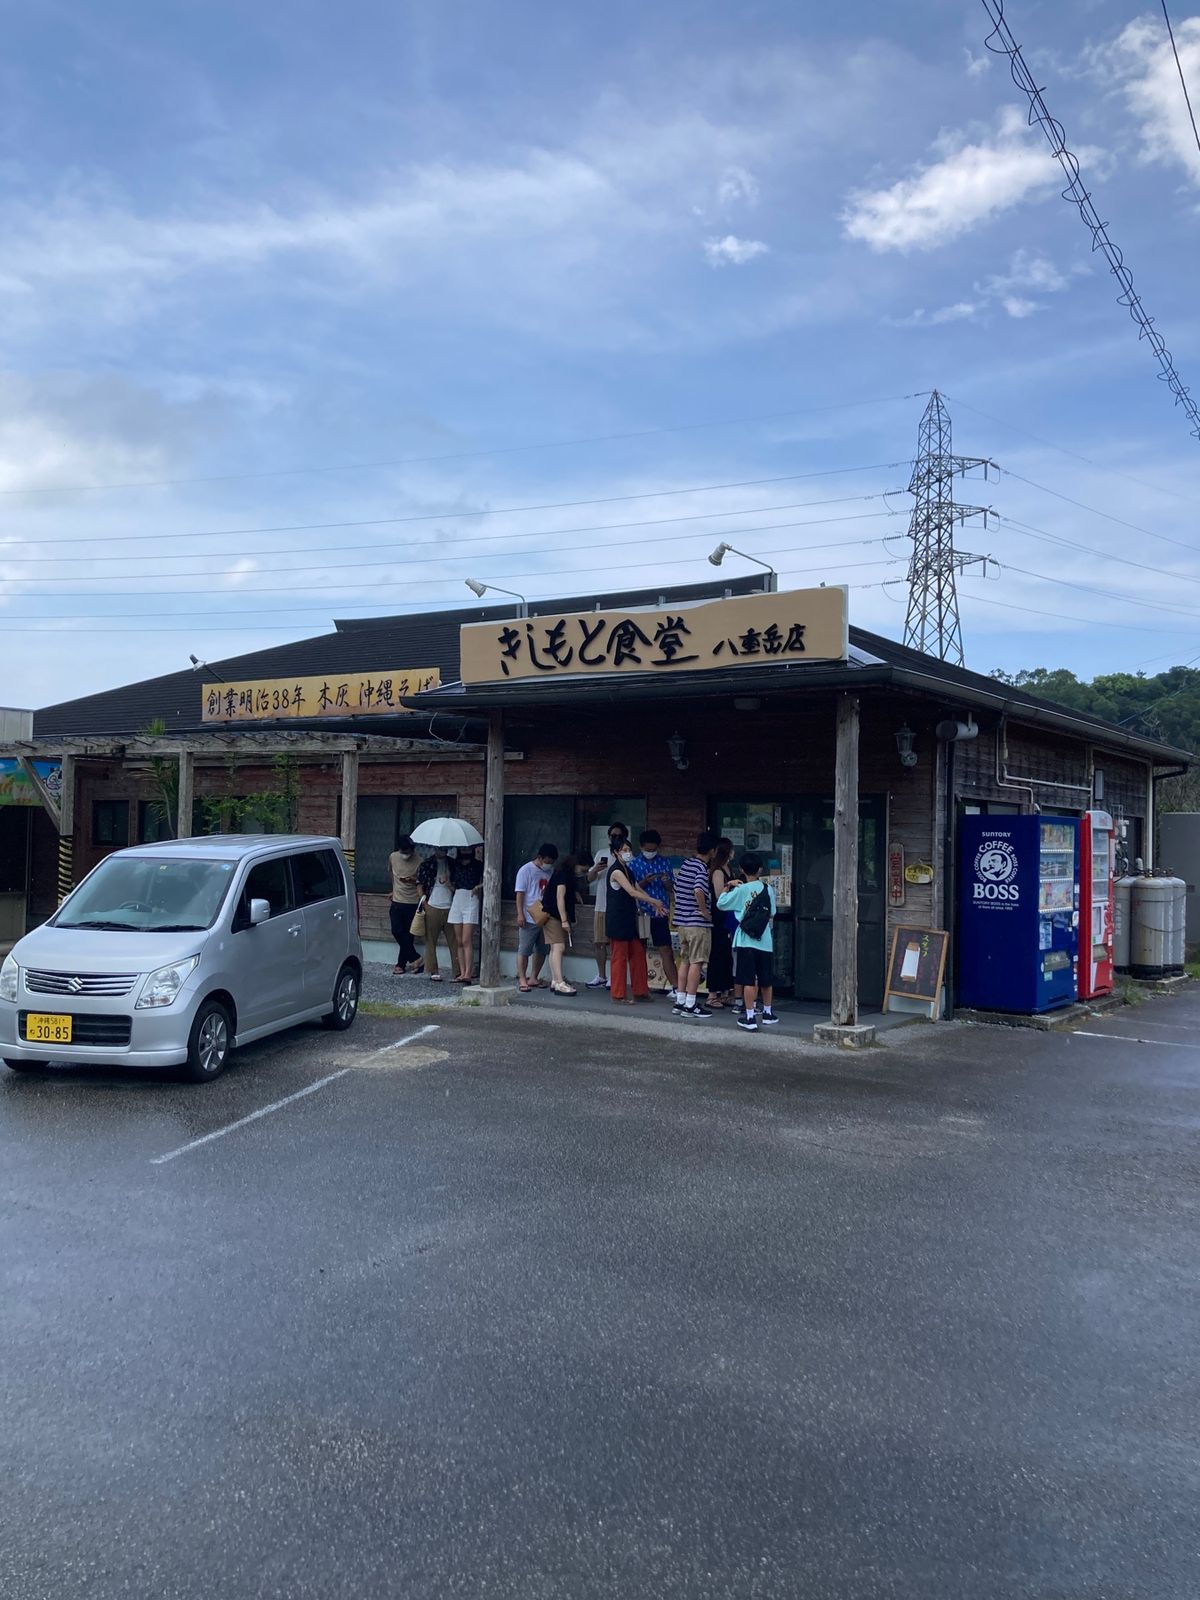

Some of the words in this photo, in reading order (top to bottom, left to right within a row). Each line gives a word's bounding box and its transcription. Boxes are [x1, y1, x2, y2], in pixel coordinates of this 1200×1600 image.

[497, 616, 699, 675] きしもと食堂
[712, 623, 807, 656] 八重岳店
[207, 684, 306, 717] 創業明治38年
[979, 841, 1014, 854] COFFEE
[973, 883, 1019, 900] BOSS
[37, 1026, 69, 1039] 30-85
